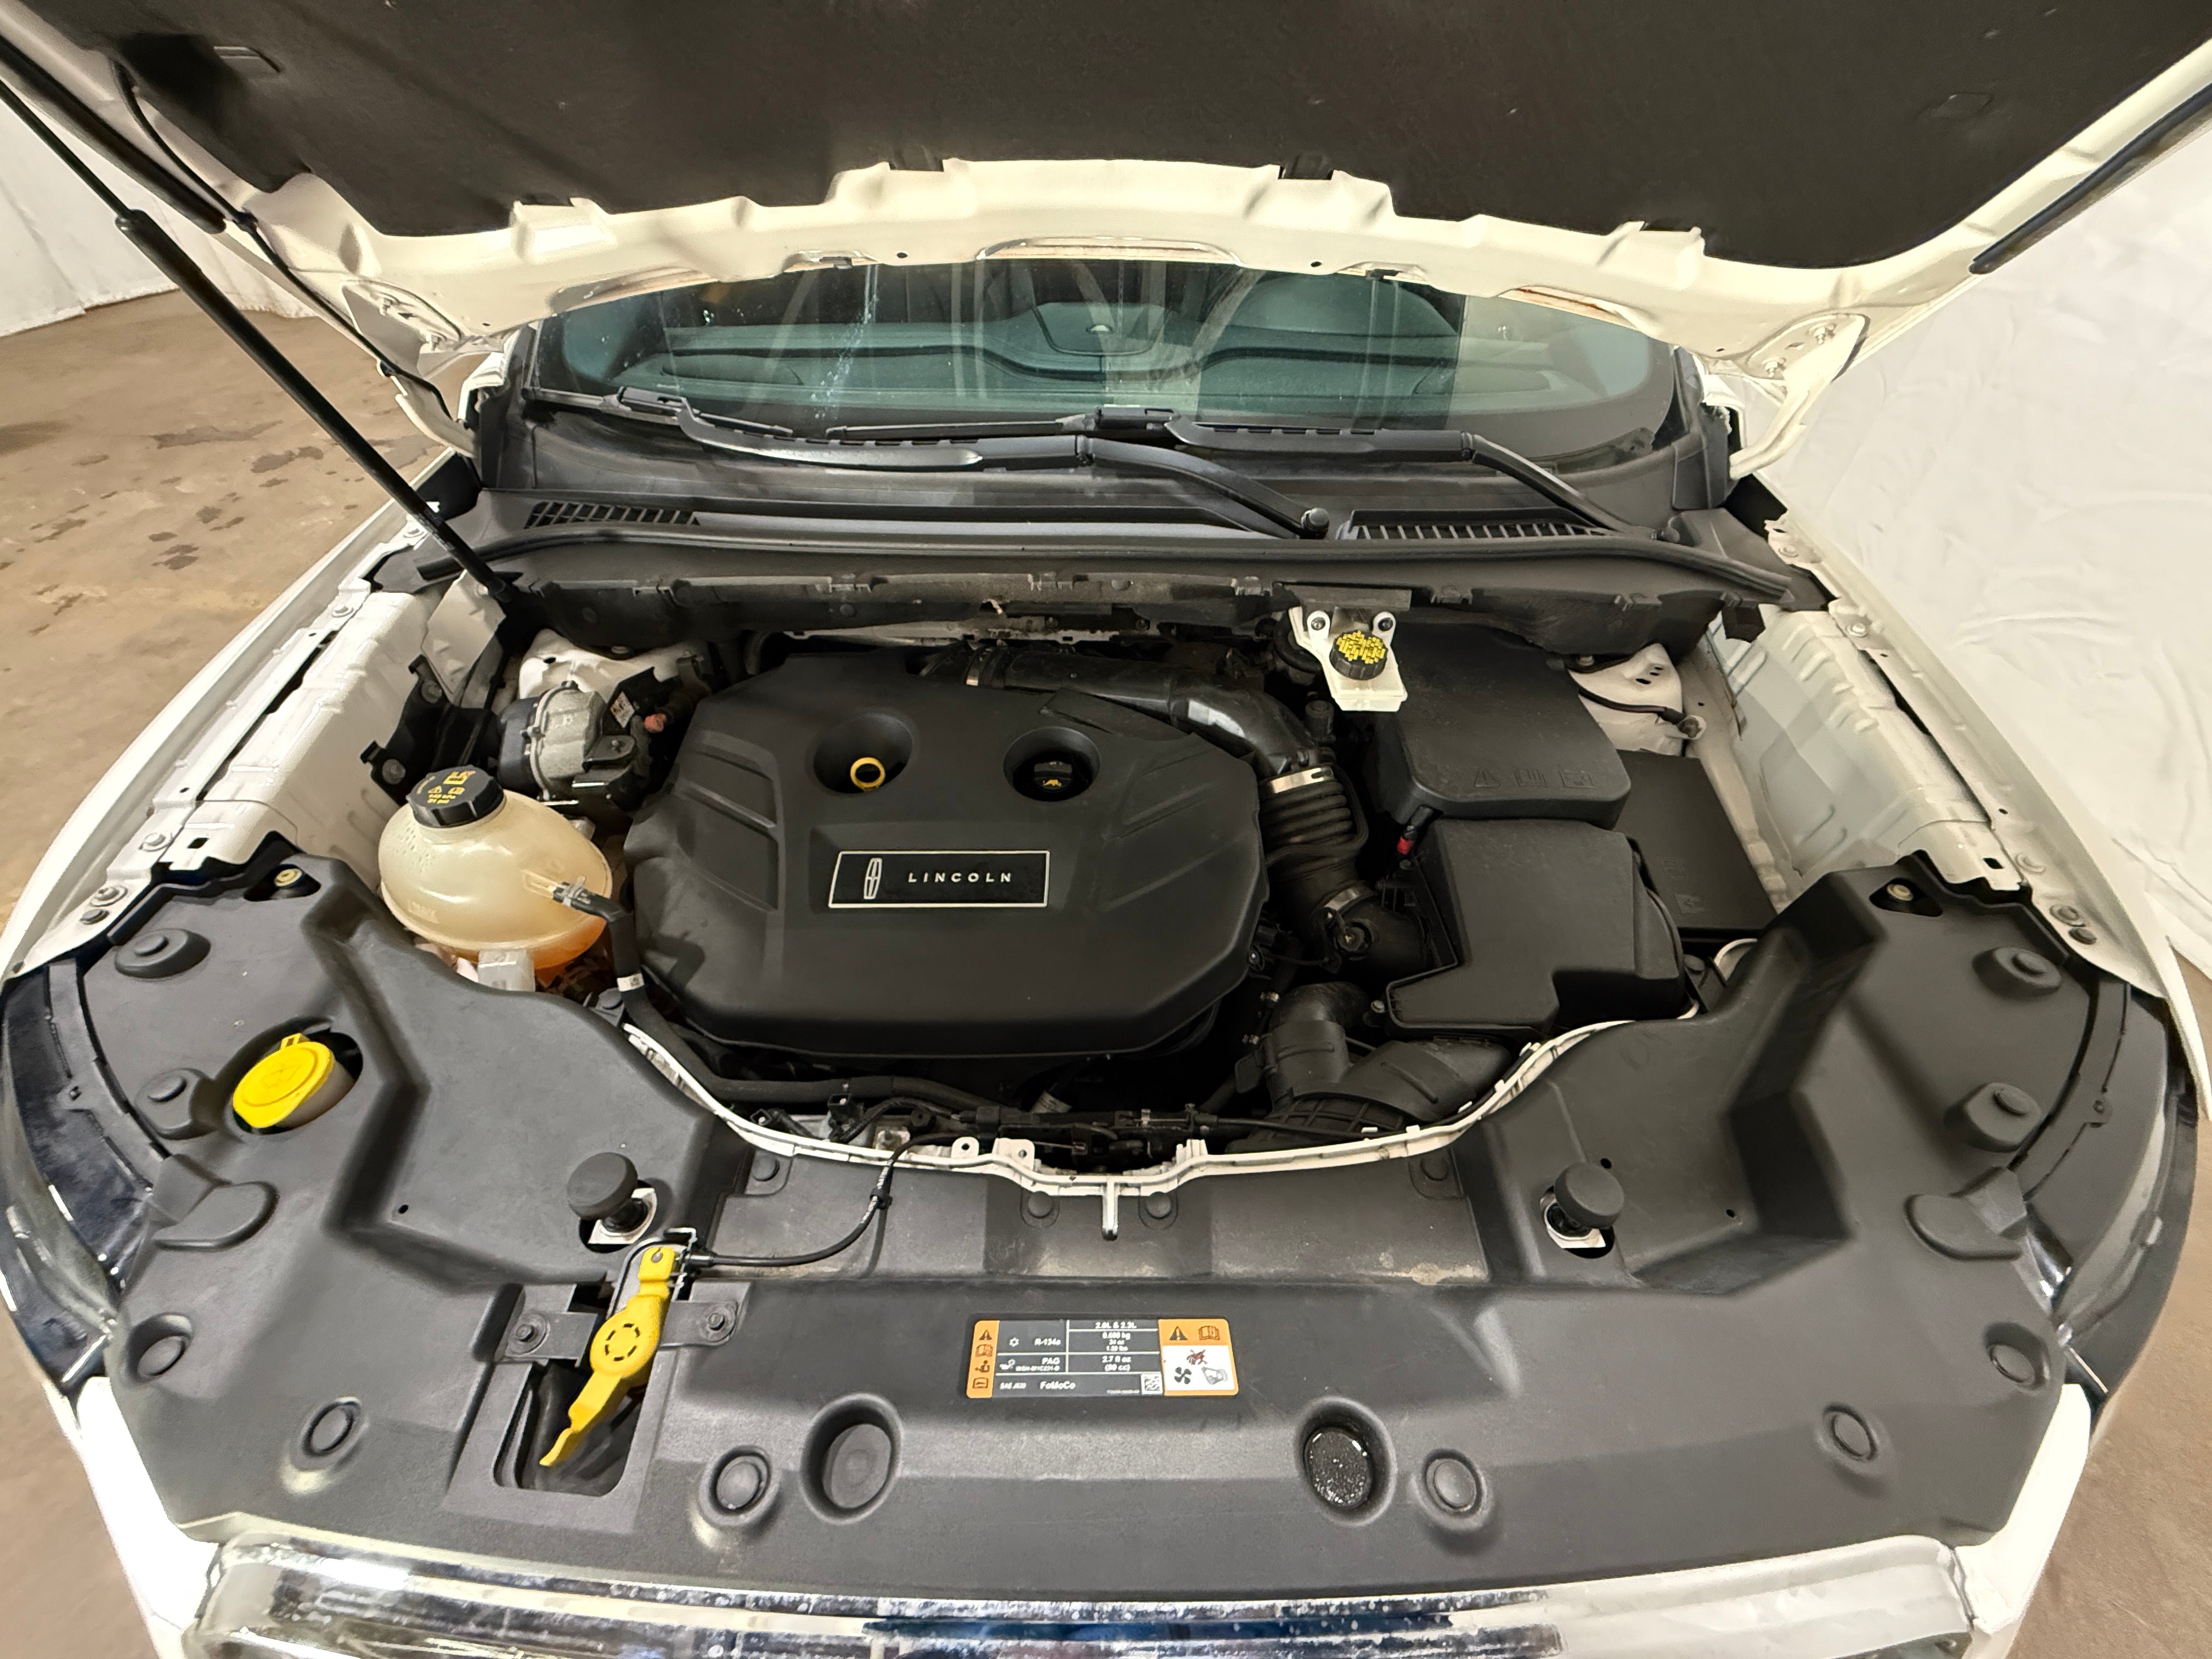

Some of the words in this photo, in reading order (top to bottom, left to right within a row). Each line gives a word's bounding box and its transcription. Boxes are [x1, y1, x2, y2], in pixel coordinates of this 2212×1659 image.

[908, 872, 1011, 883] LINCOLN
[1121, 1331, 1131, 1340] kg
[1040, 1380, 1076, 1390] FoMoCo
